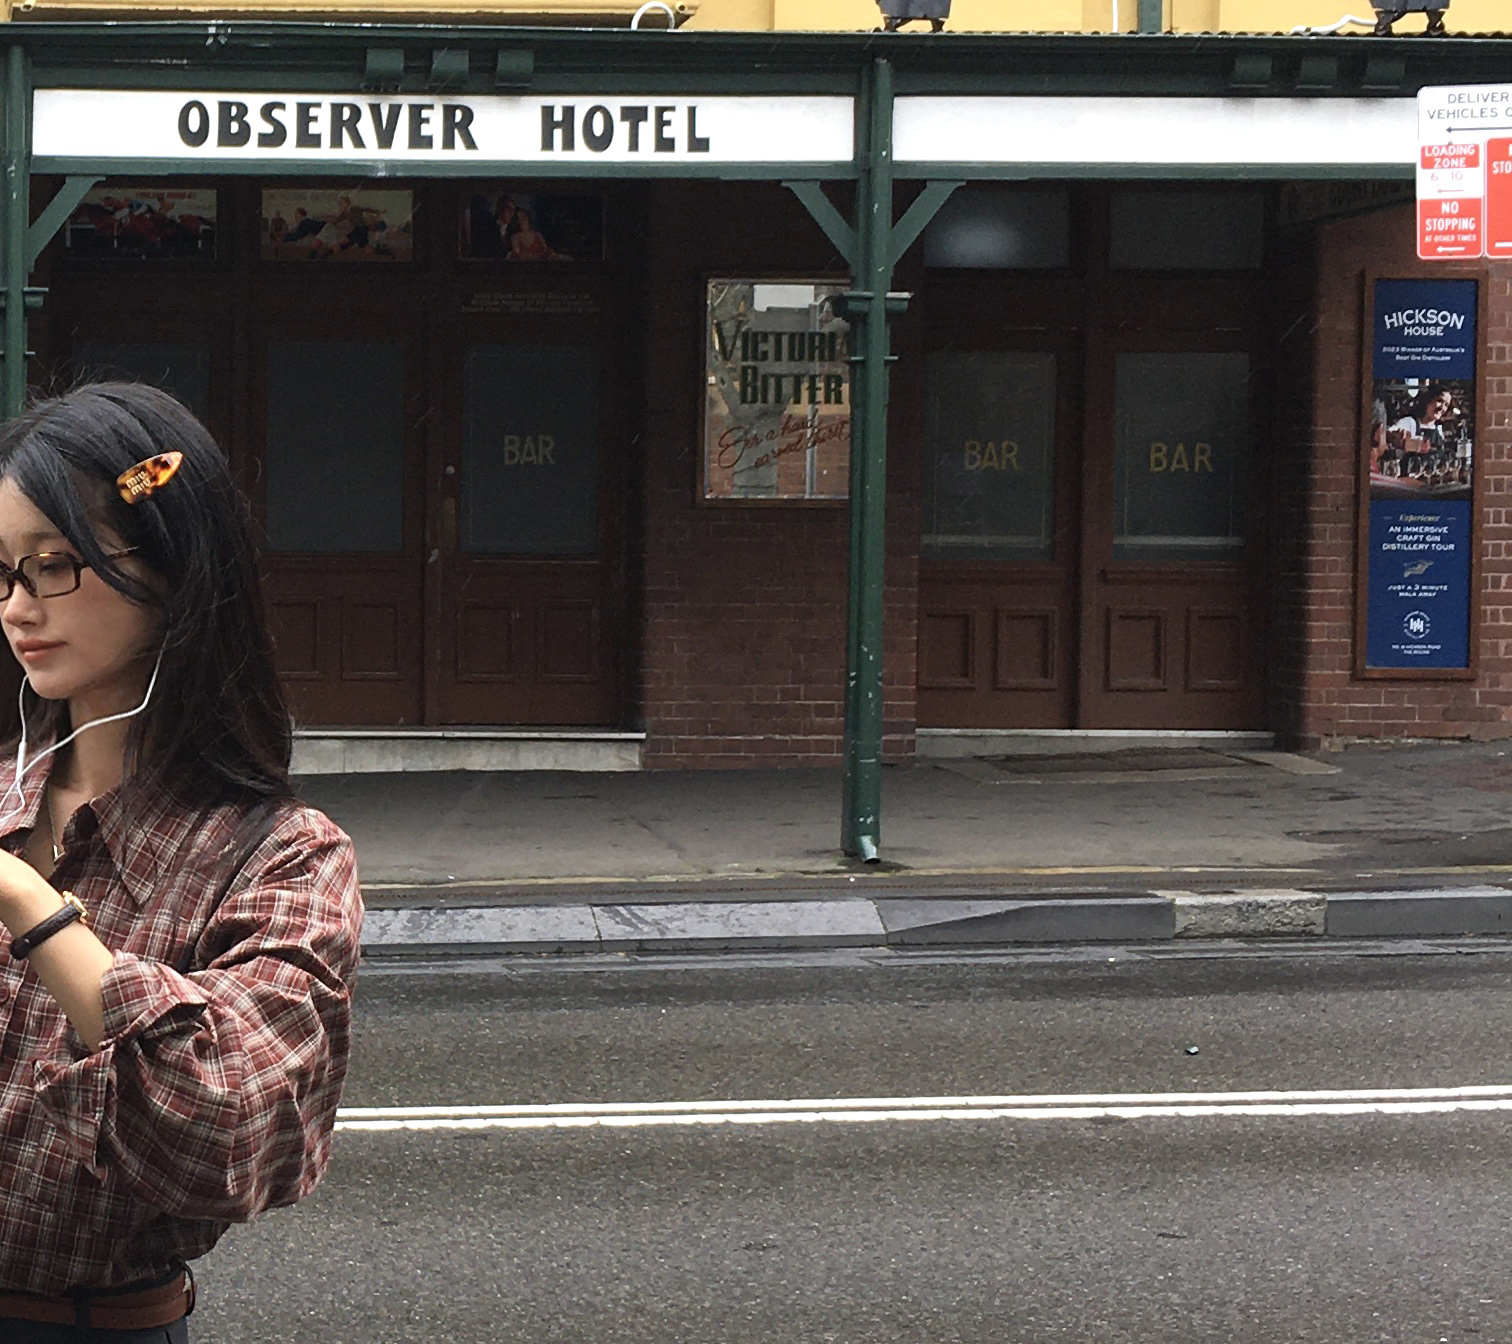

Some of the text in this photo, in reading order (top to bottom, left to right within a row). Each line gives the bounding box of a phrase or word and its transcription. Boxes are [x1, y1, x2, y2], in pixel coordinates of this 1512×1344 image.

[1448, 92, 1510, 104] DELIVER
[1427, 107, 1499, 119] VEHICLES
[177, 99, 710, 153] OBSERVER HOTEL
[1424, 145, 1476, 156] LOADING
[1434, 157, 1467, 168] ZONE
[1441, 202, 1459, 214] NO
[1425, 218, 1476, 231] STOPPING
[1384, 309, 1465, 330] HICKSON
[1404, 326, 1444, 336] HOUSE
[711, 320, 838, 362] VICTORI
[740, 365, 843, 404] BITTER
[504, 434, 556, 464] BAR
[964, 440, 1019, 471] BAR
[1149, 442, 1213, 472] BAR
[126, 471, 147, 488] miu
[131, 478, 151, 495] miu
[1431, 543, 1455, 551] TOUR
